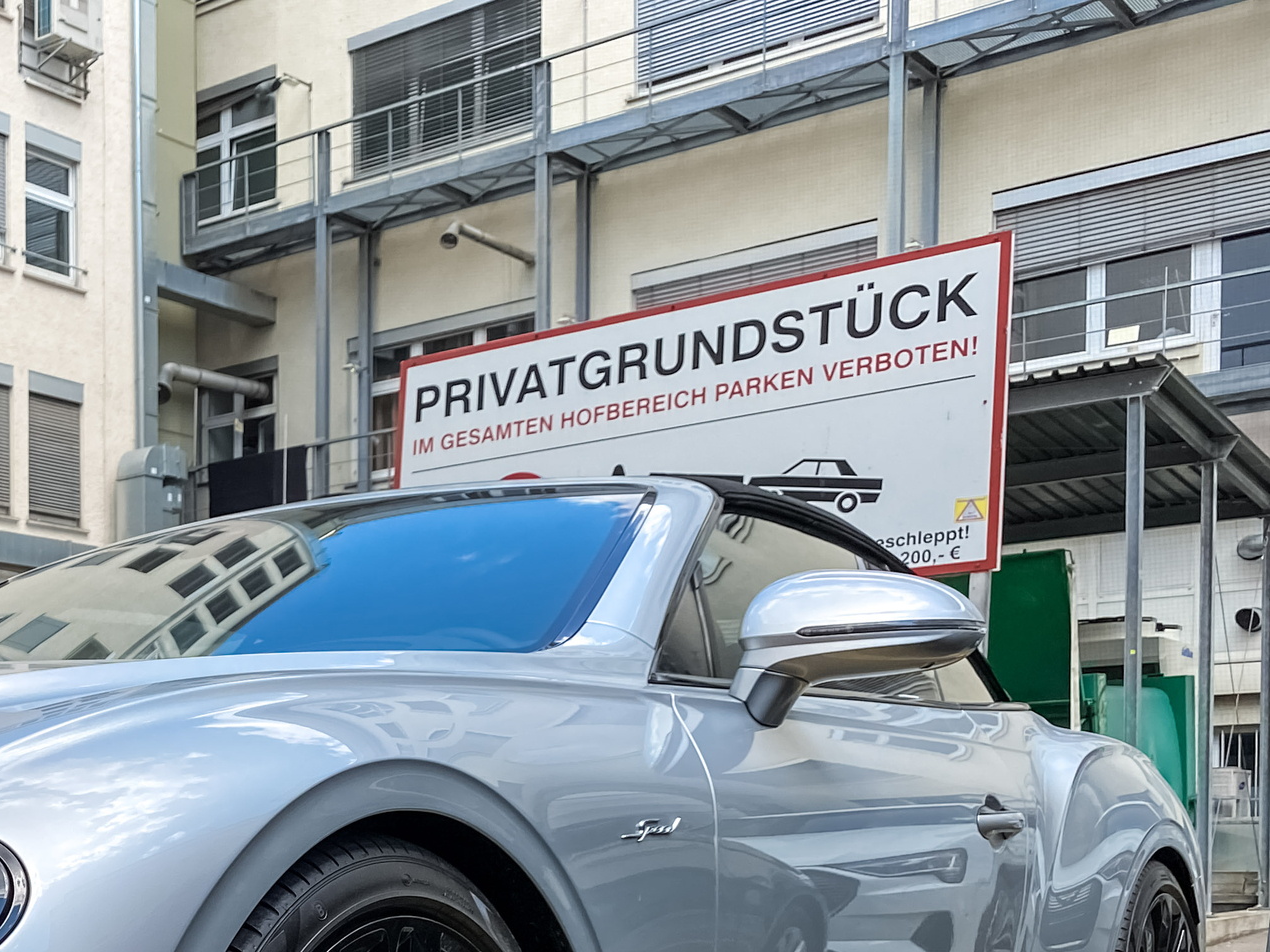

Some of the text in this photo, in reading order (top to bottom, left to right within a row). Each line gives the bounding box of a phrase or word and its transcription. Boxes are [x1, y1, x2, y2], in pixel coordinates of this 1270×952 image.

[412, 334, 980, 456] IM GESAMTEN HOFBEREICH PARKEN VERBOTEN!
[414, 271, 980, 423] PRIVATGRUNDSTÜCK
[875, 525, 970, 549] eschleppt!
